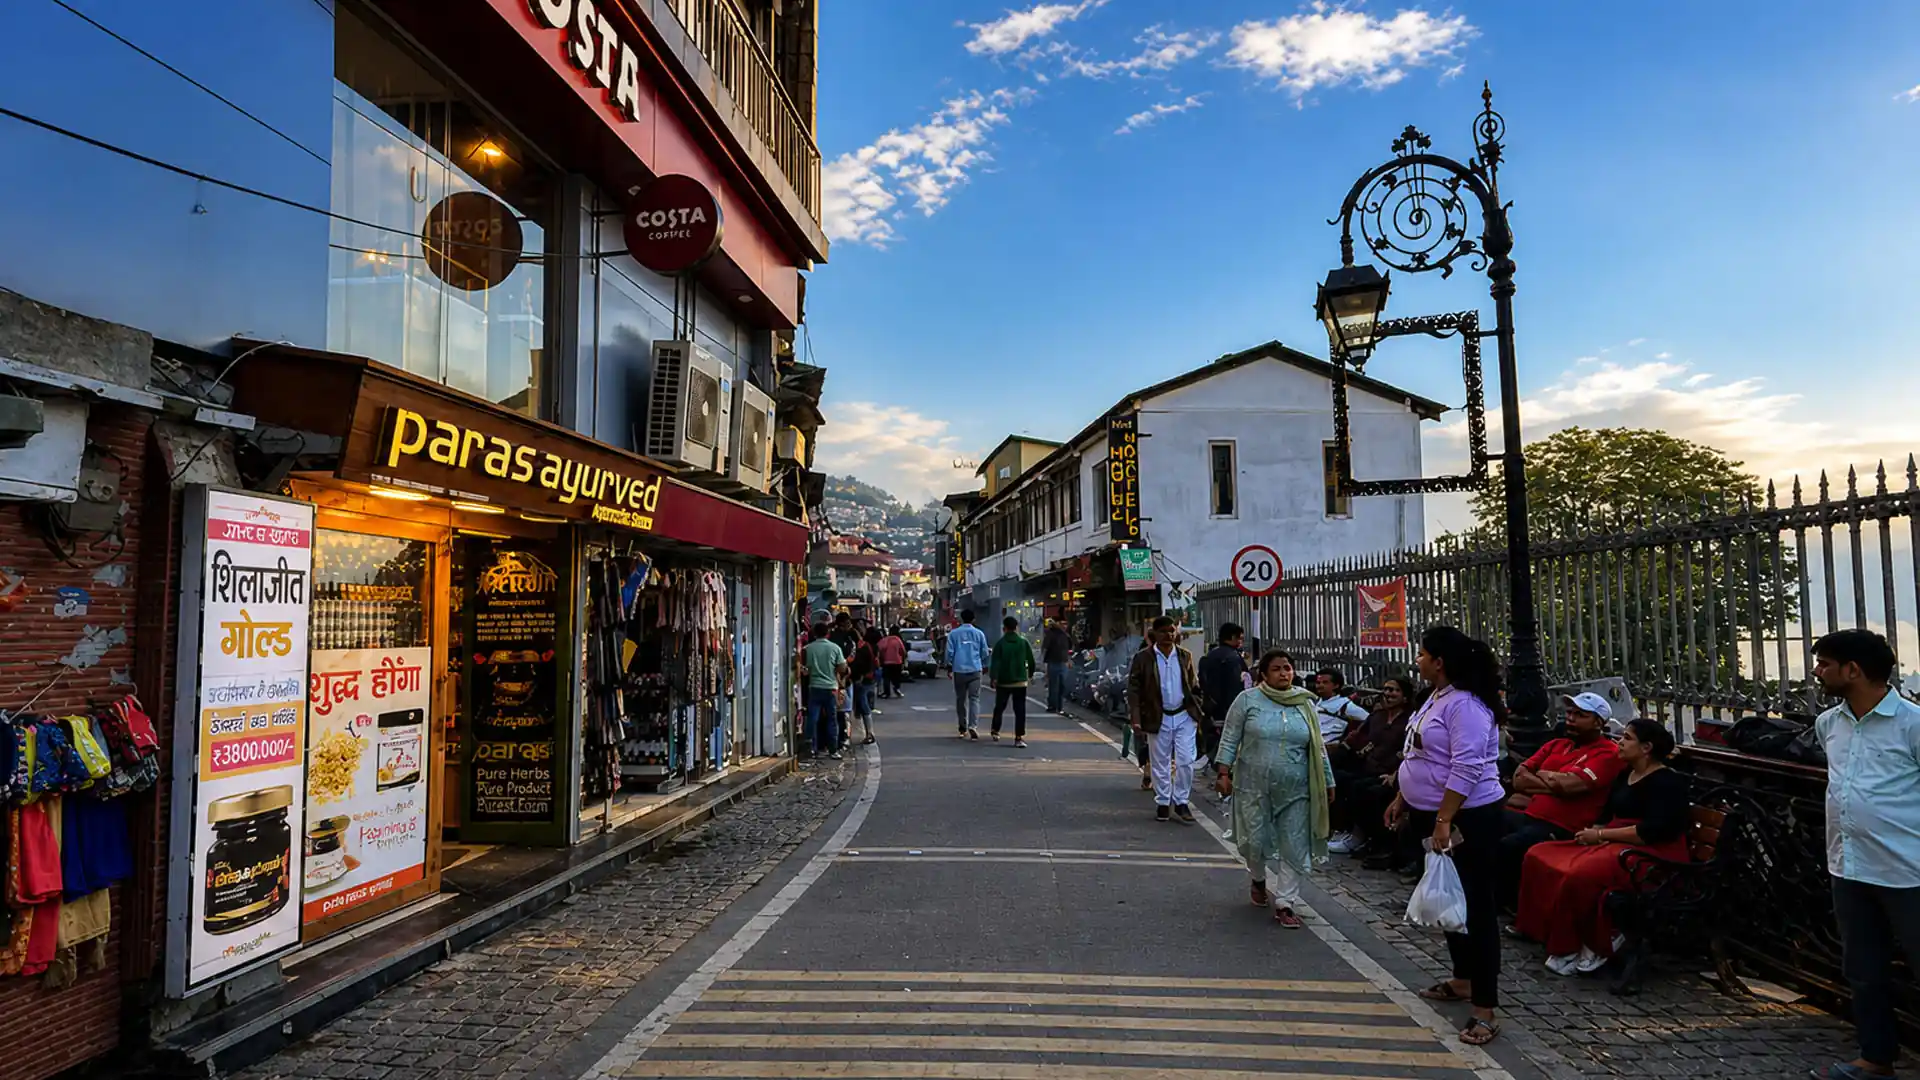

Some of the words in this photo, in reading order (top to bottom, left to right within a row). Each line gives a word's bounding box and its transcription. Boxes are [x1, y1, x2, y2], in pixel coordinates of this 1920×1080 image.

[636, 206, 706, 229] COSTA
[388, 407, 537, 483] paras
[540, 452, 662, 513] ayurved
[211, 549, 306, 604] शिलाजीत
[1241, 560, 1273, 582] 20
[220, 608, 293, 658] गोल्ड
[477, 767, 507, 780] Pure
[510, 765, 550, 780] Herbs
[507, 781, 552, 796] Product
